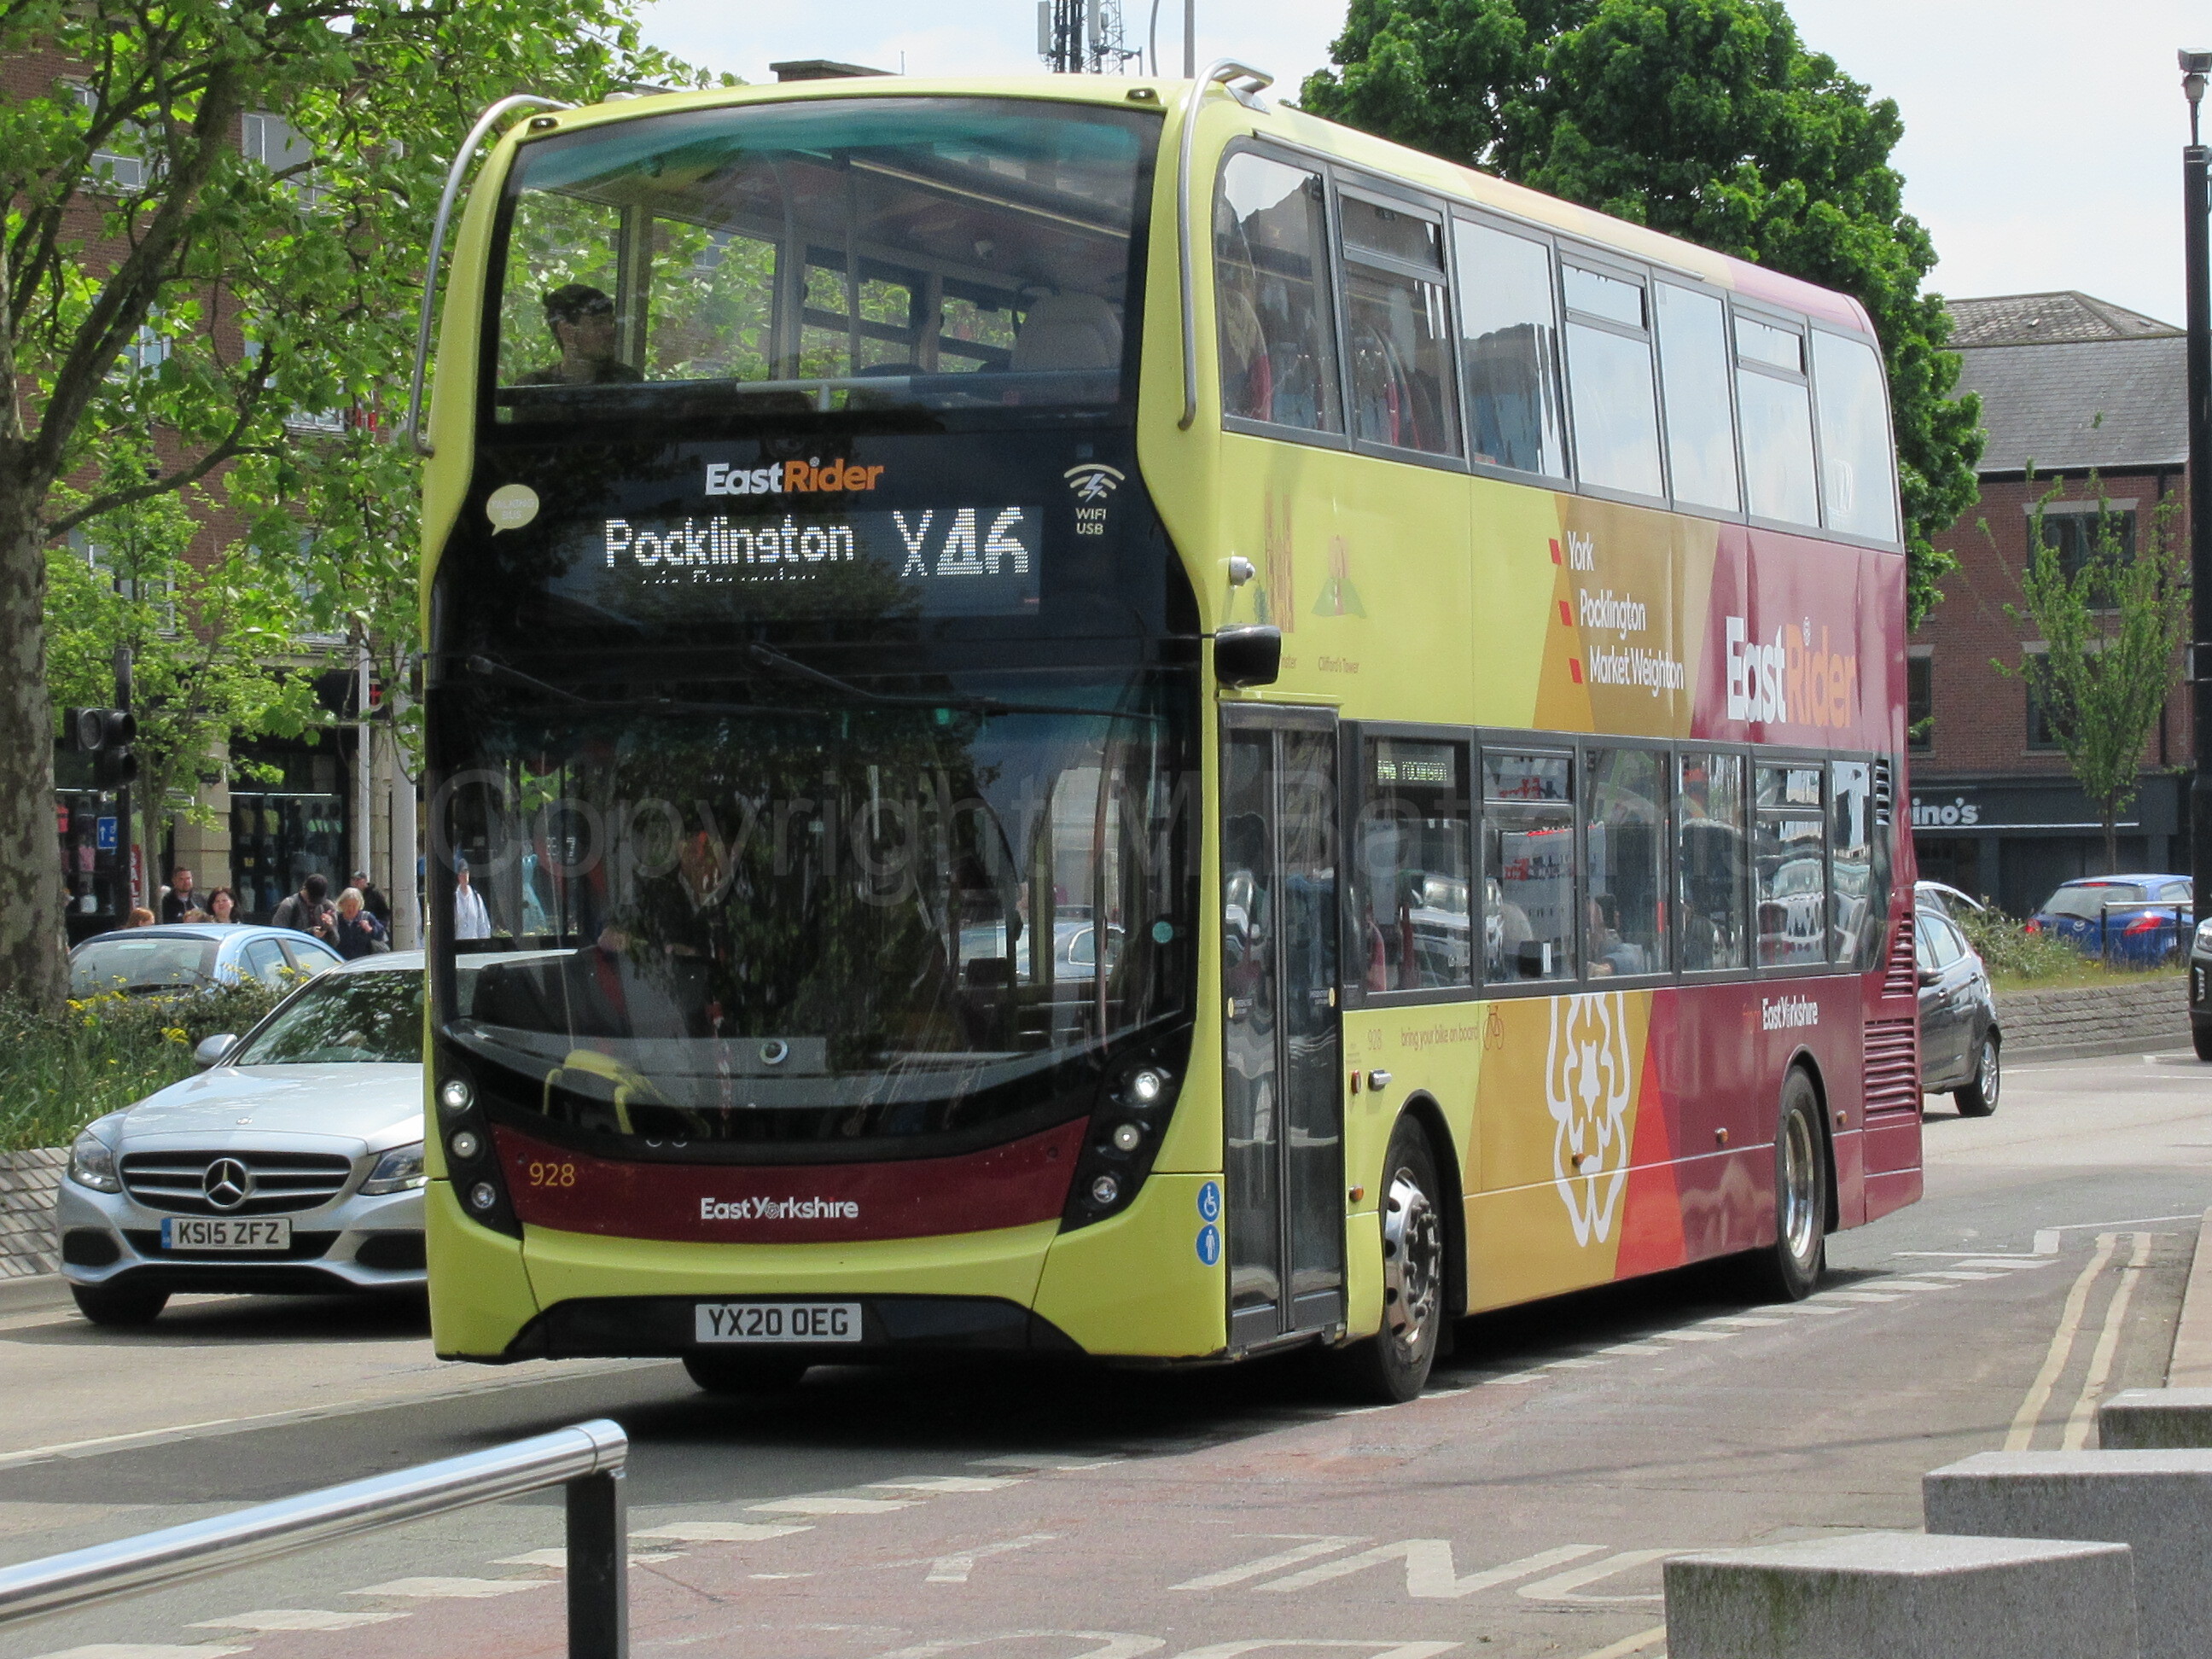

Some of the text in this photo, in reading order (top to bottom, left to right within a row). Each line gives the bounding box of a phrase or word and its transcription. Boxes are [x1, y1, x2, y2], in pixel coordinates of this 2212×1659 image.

[1075, 508, 1107, 521] WIFI
[1076, 522, 1104, 535] USB
[606, 506, 1029, 577] Pocklington X46
[1568, 531, 1594, 571] York
[1580, 588, 1646, 640] Pocklington
[1590, 645, 1684, 697] Market Weighton
[1912, 797, 1979, 825] ino's
[529, 1161, 575, 1187] 928
[178, 1222, 279, 1244] KS15 ZFZ
[708, 1308, 848, 1336] YX20 OEG
